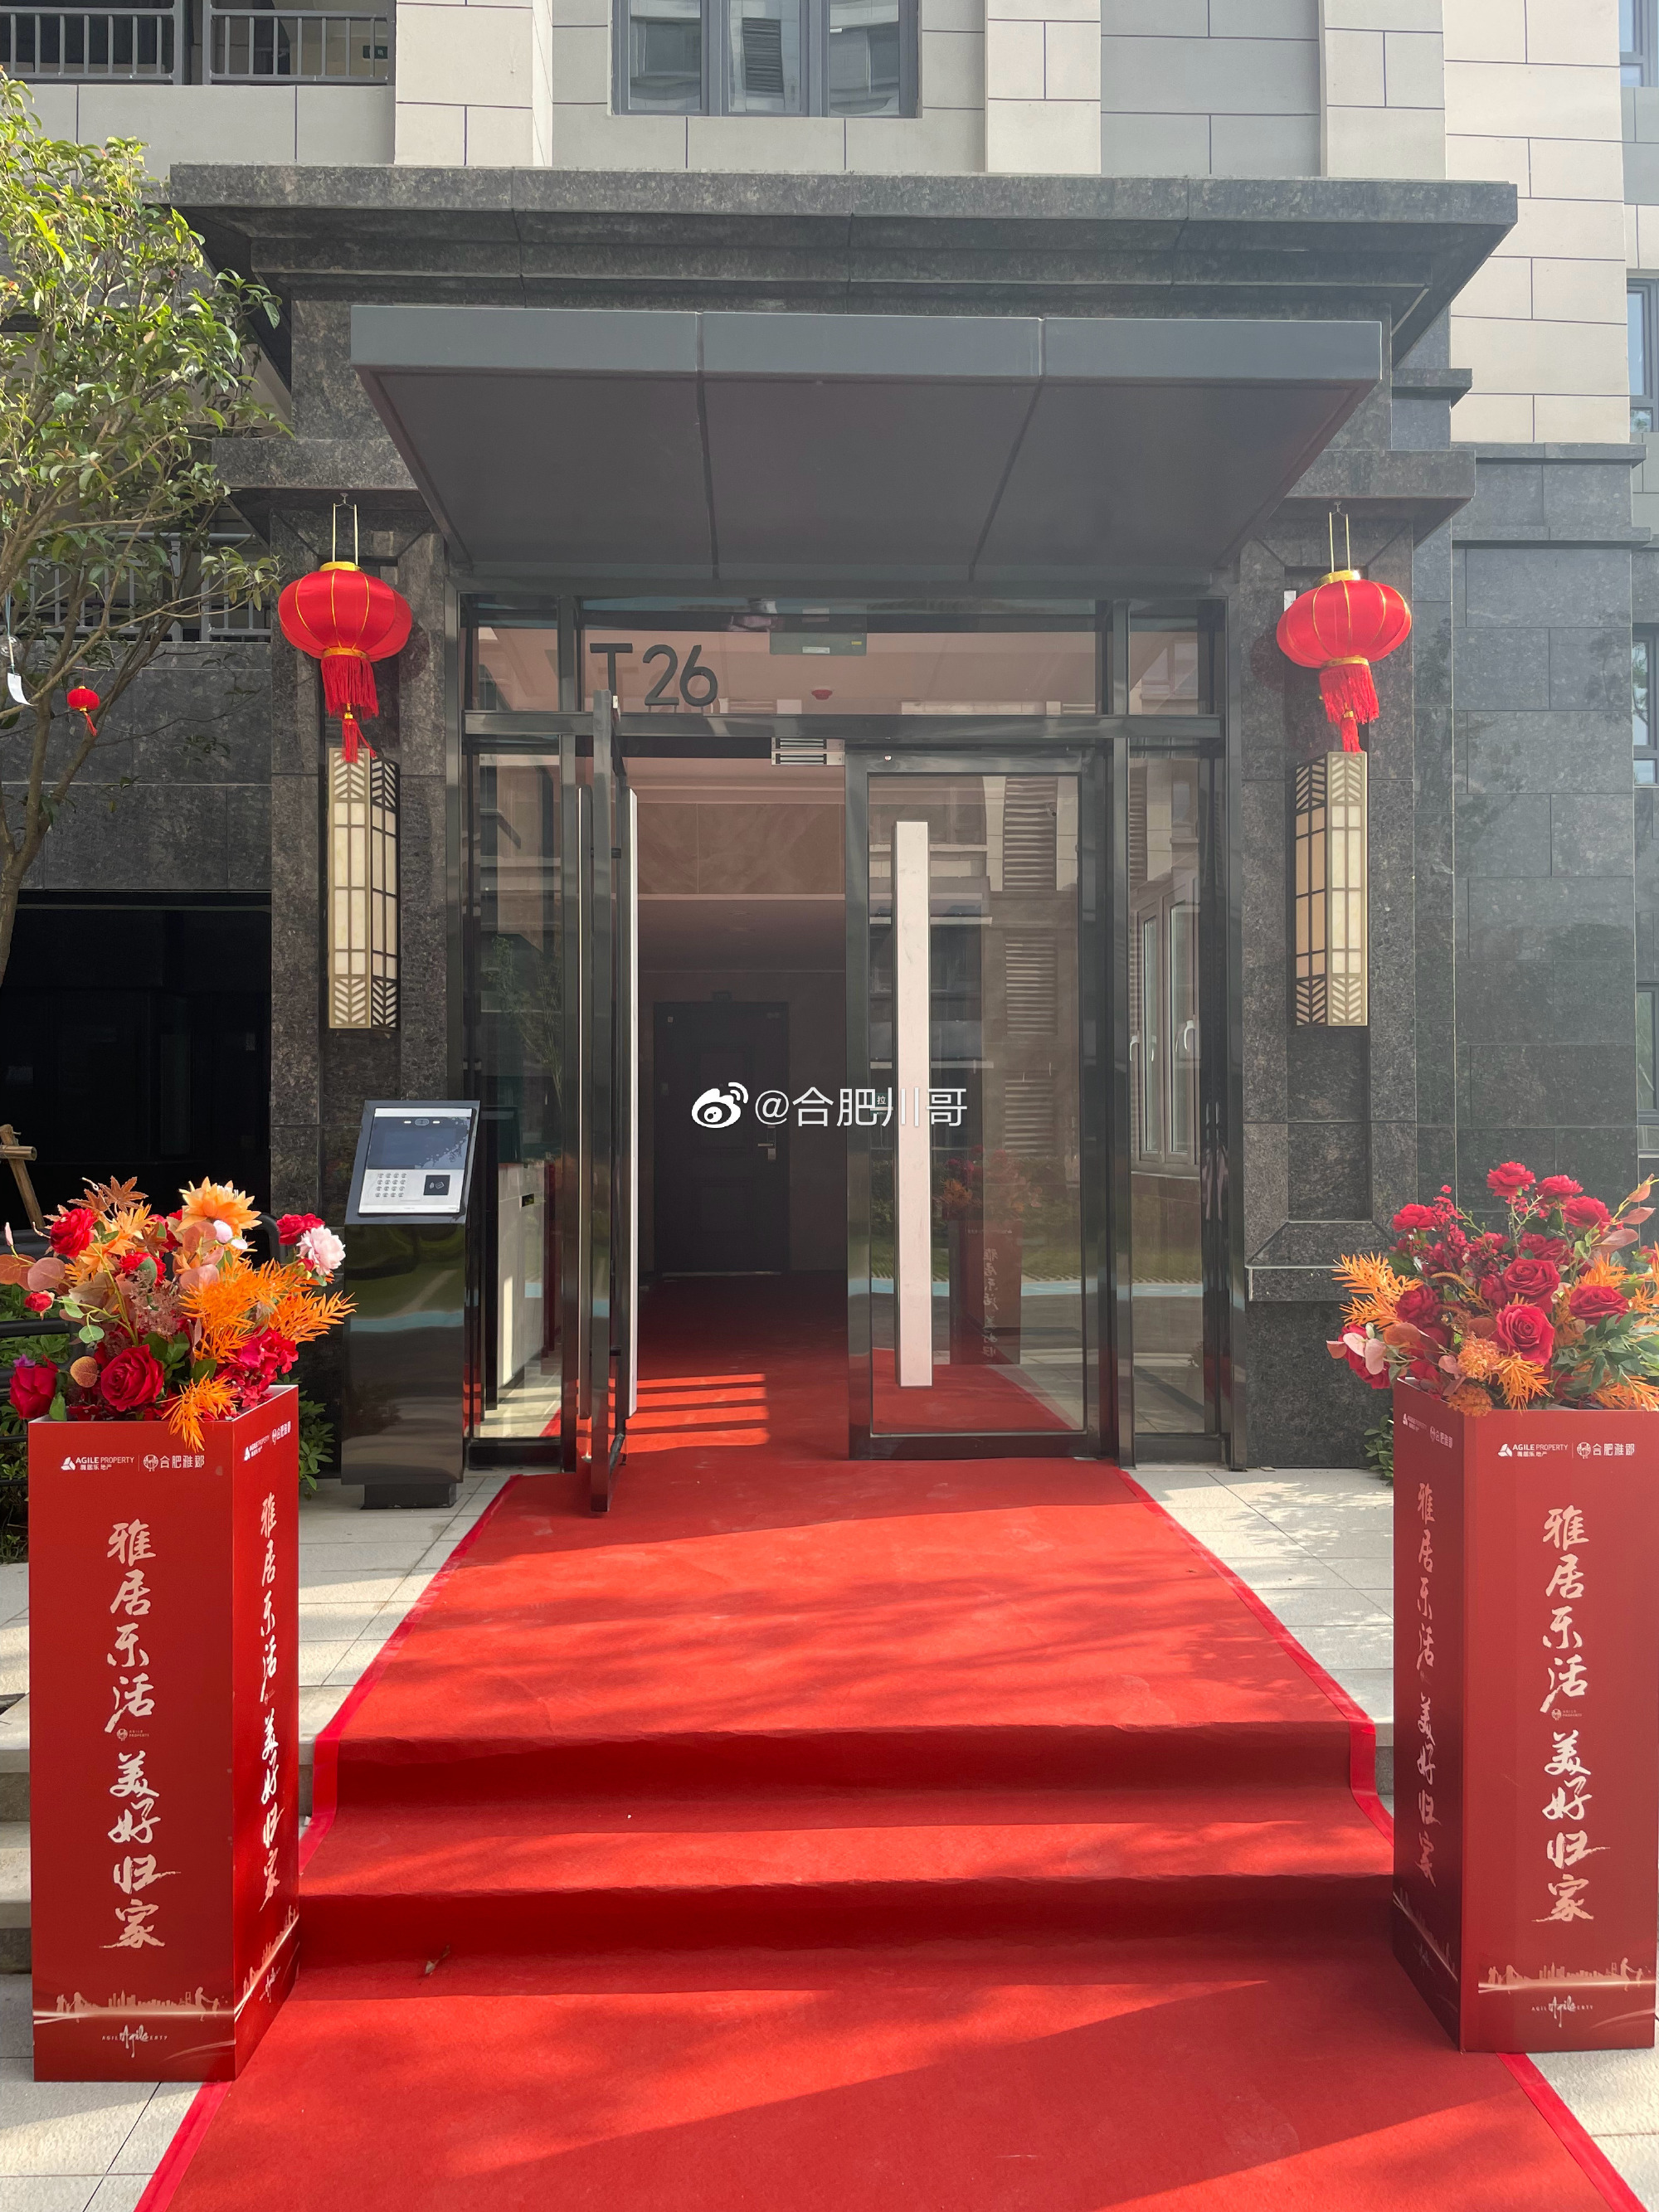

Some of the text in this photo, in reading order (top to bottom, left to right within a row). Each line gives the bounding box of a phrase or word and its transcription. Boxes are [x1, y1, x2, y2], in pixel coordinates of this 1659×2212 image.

[877, 1095, 887, 1105] 拉
[160, 1455, 205, 1469] 合肥雅郡
[99, 1518, 182, 1949] 雅居乐活 美好归家
[1531, 1505, 1611, 1922] 雅居乐活 美好归家
